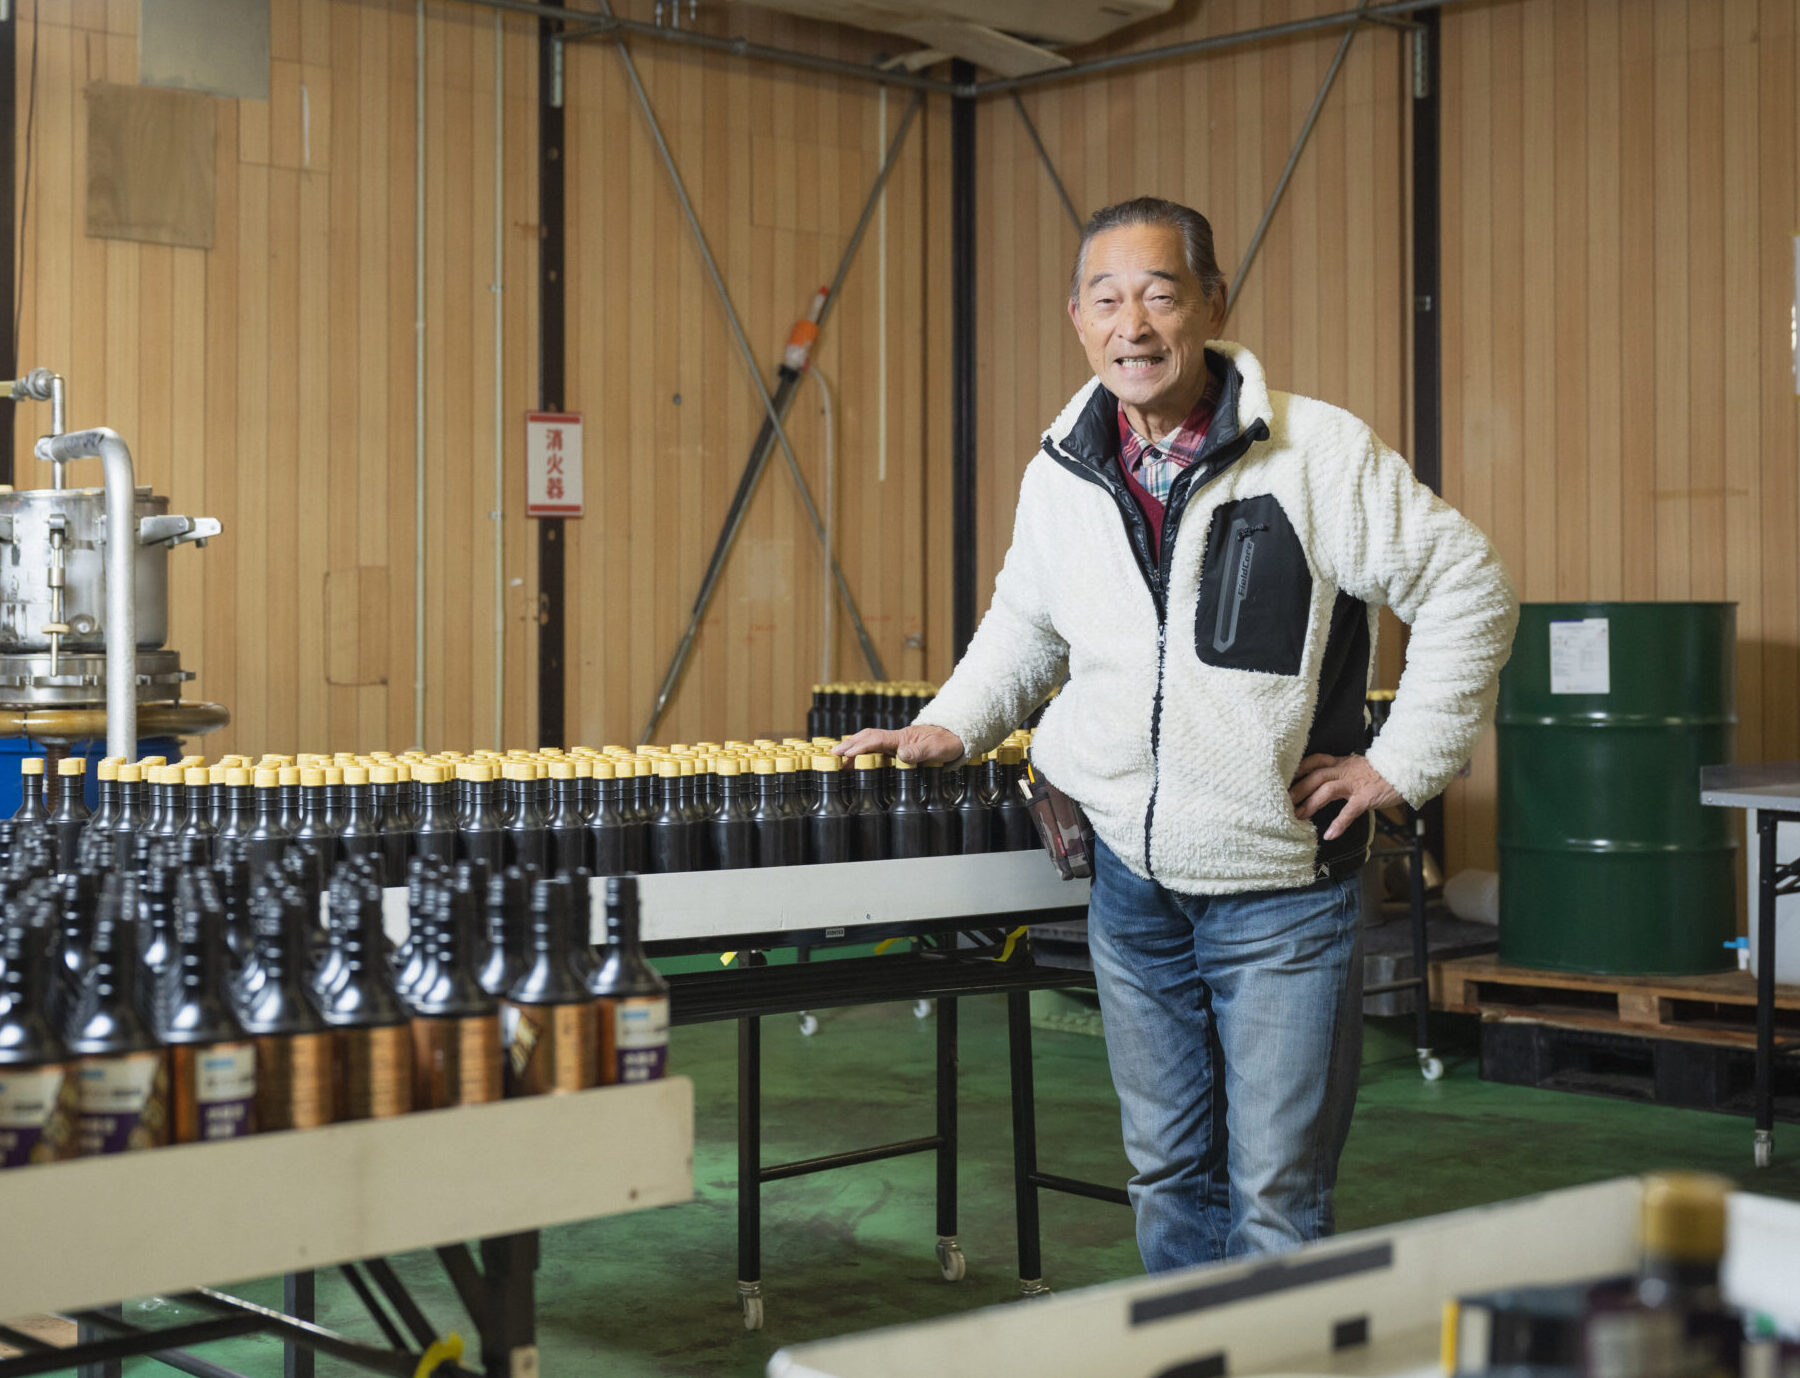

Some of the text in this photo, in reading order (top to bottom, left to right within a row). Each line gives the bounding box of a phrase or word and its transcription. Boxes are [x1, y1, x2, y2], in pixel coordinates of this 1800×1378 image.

[545, 428, 564, 500] 消火器
[1238, 543, 1254, 598] FieldCore
